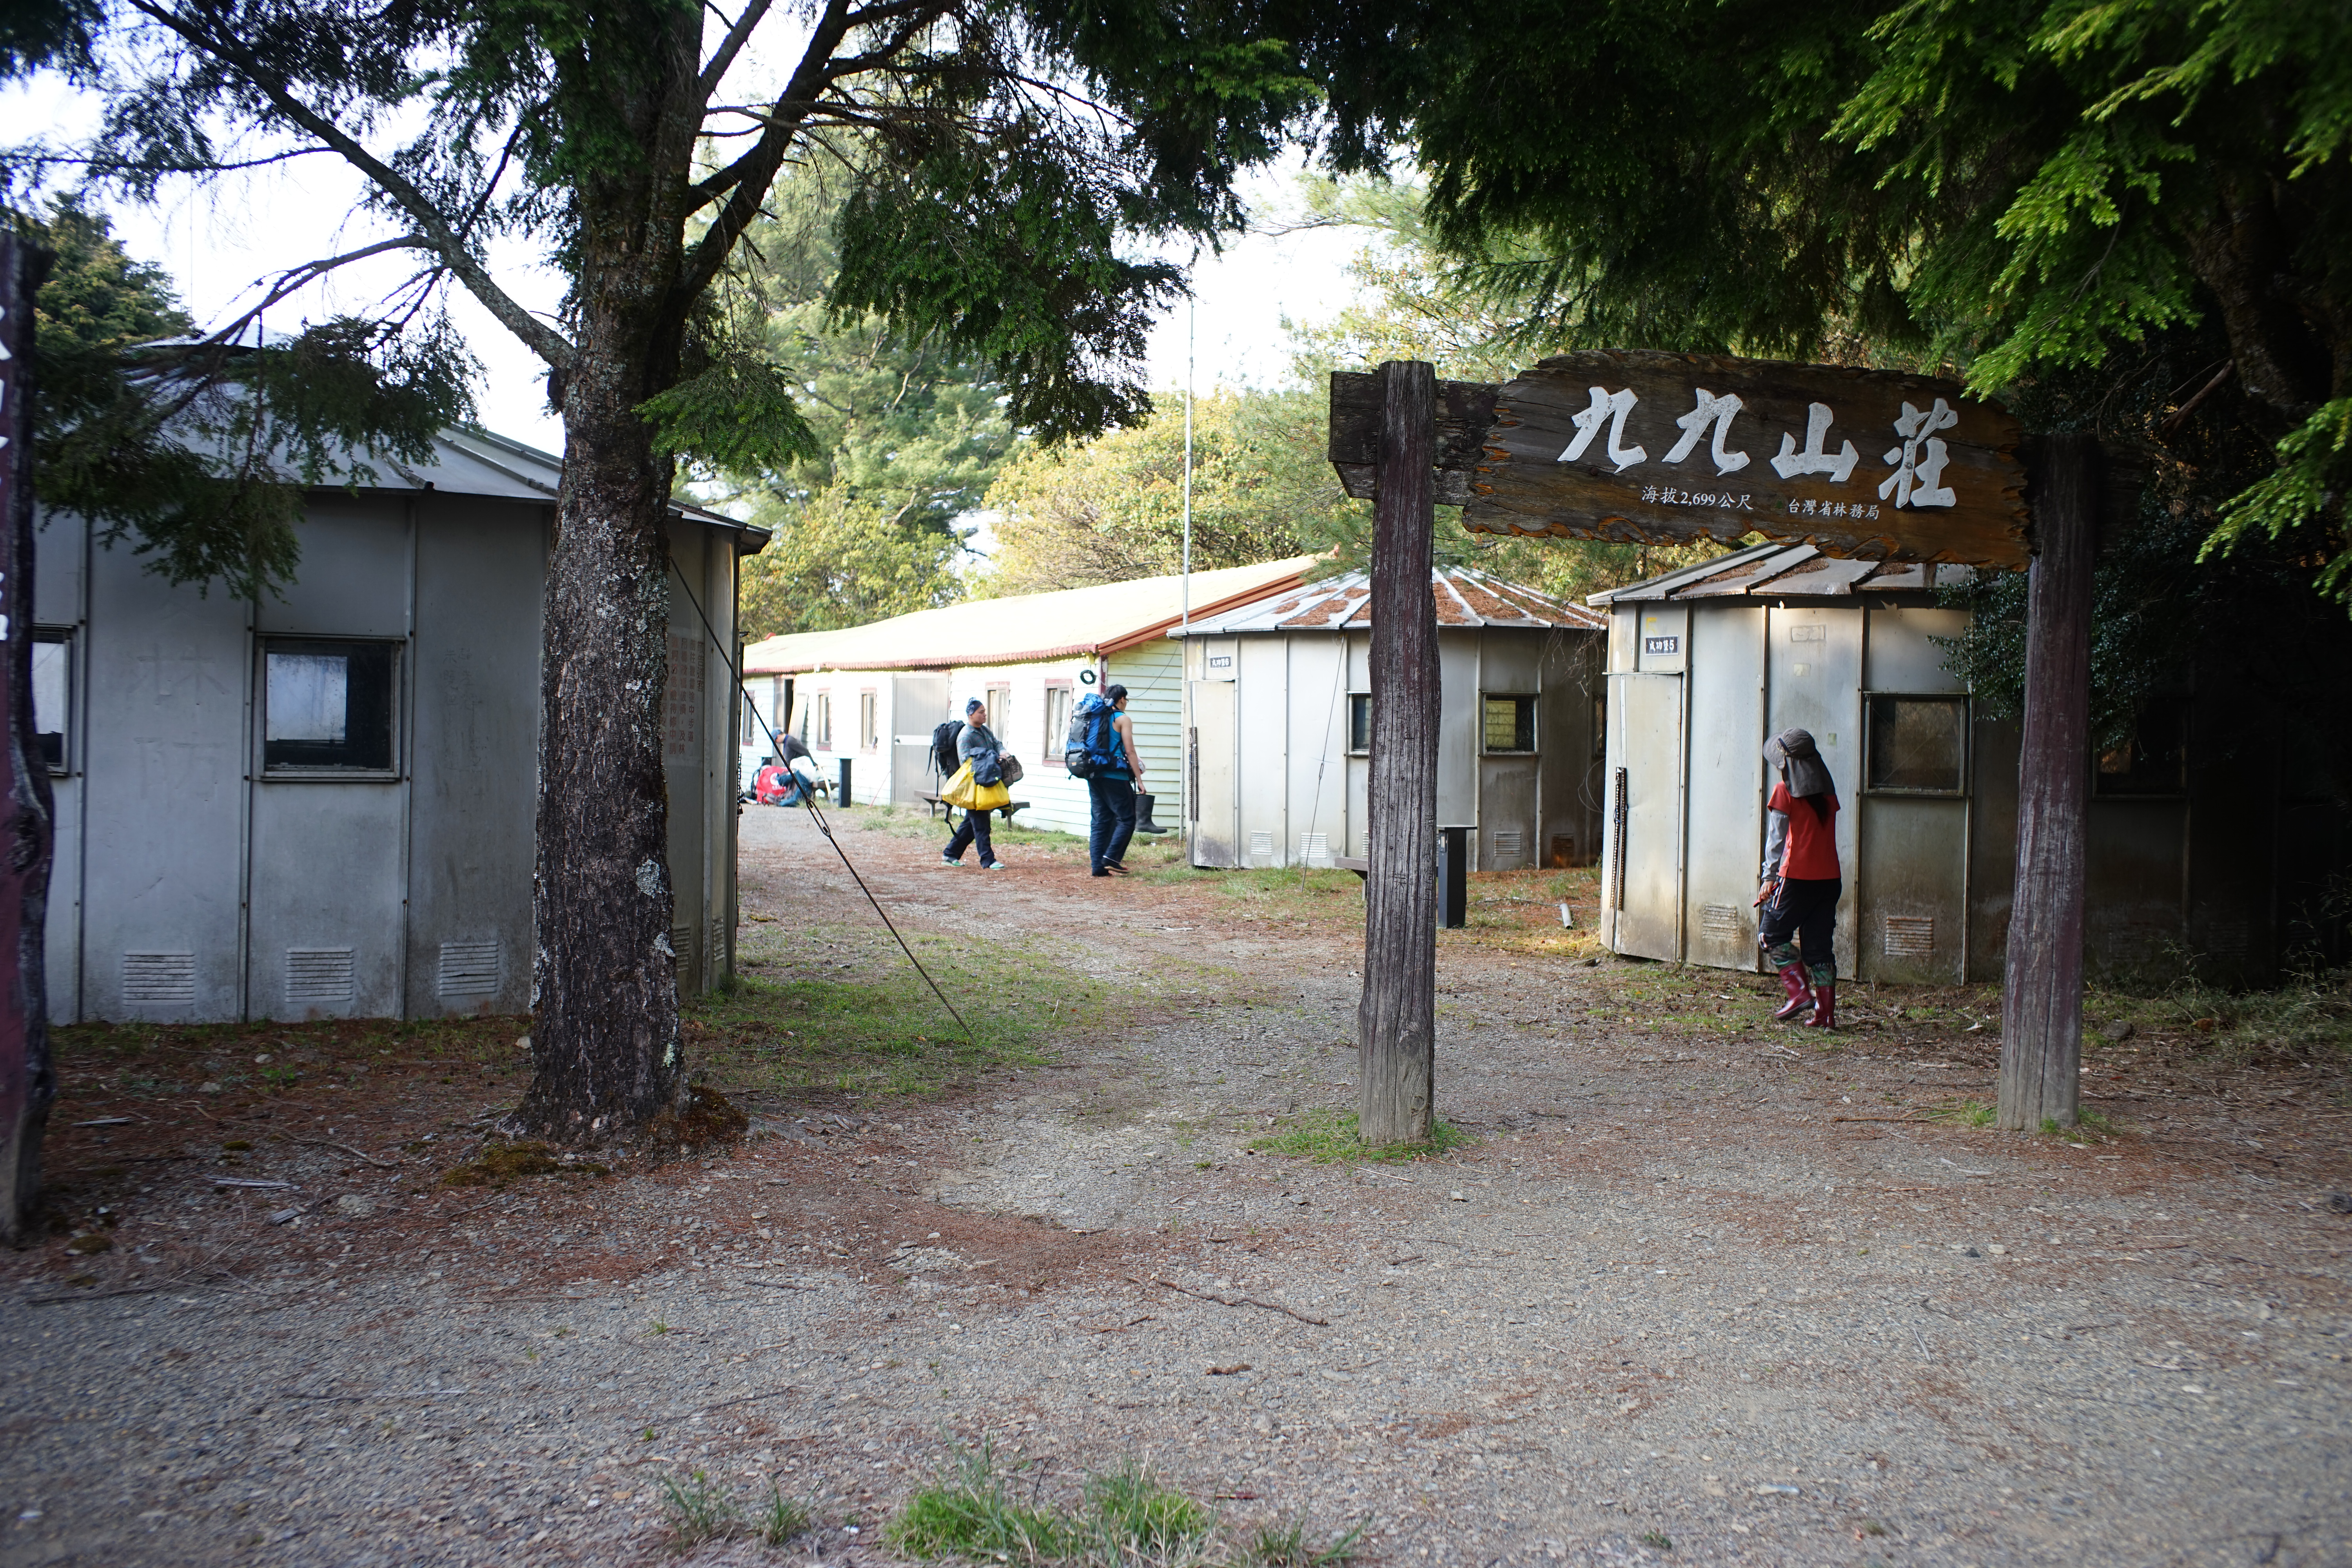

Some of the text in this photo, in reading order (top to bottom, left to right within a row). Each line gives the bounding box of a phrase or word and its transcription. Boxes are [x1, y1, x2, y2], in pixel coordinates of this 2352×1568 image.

[1557, 386, 1958, 509] 九九山莊
[1641, 485, 1754, 510] 海拔2,699公尺
[1788, 498, 1880, 521] 台灣省林務局
